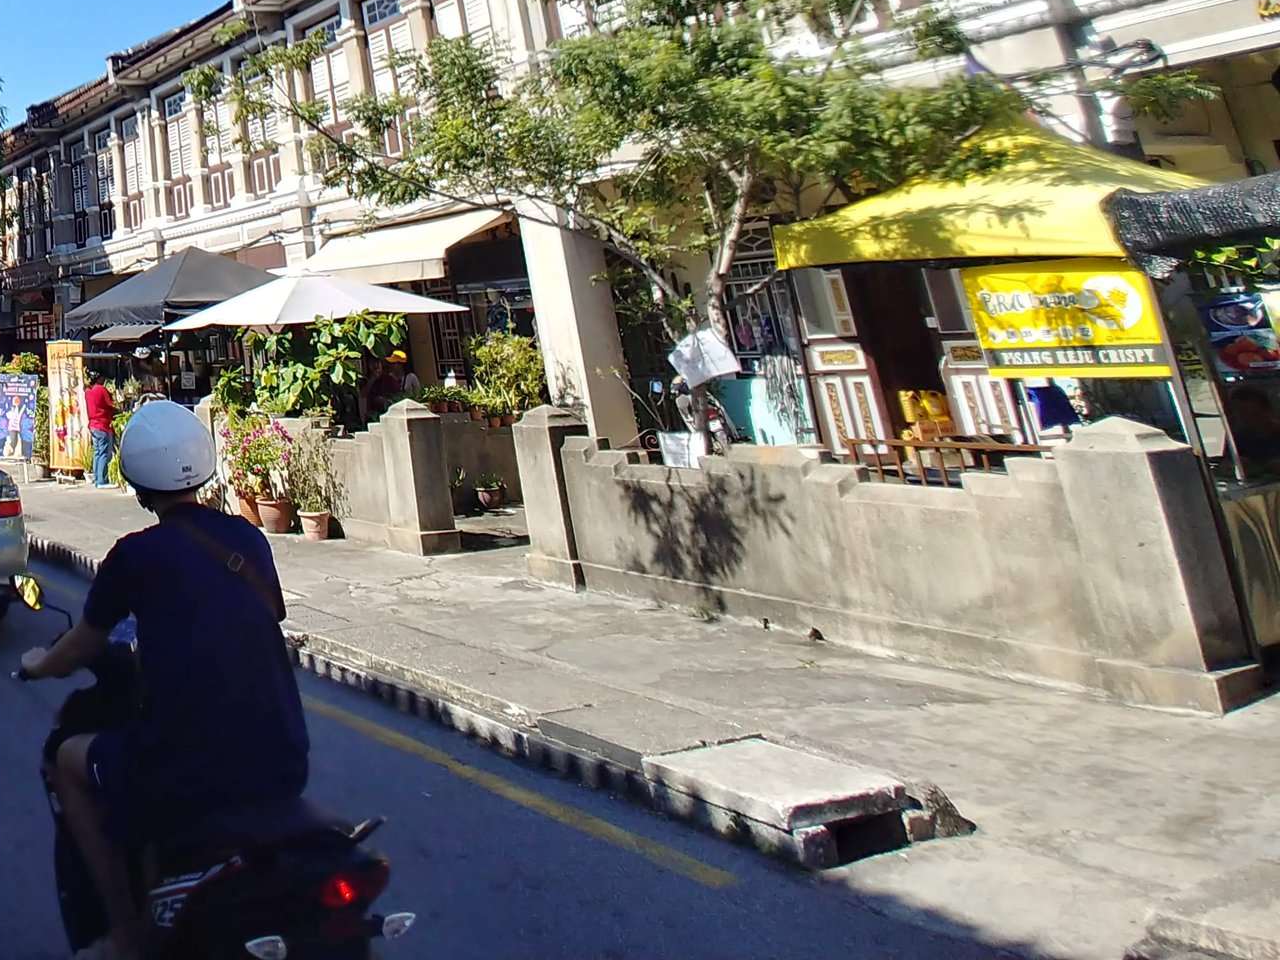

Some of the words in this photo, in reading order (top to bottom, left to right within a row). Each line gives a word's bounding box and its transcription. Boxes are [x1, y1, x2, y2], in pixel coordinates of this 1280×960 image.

[1000, 350, 1053, 365] PISANG
[1055, 350, 1094, 364] KEJU
[1098, 349, 1155, 363] CRISPY
